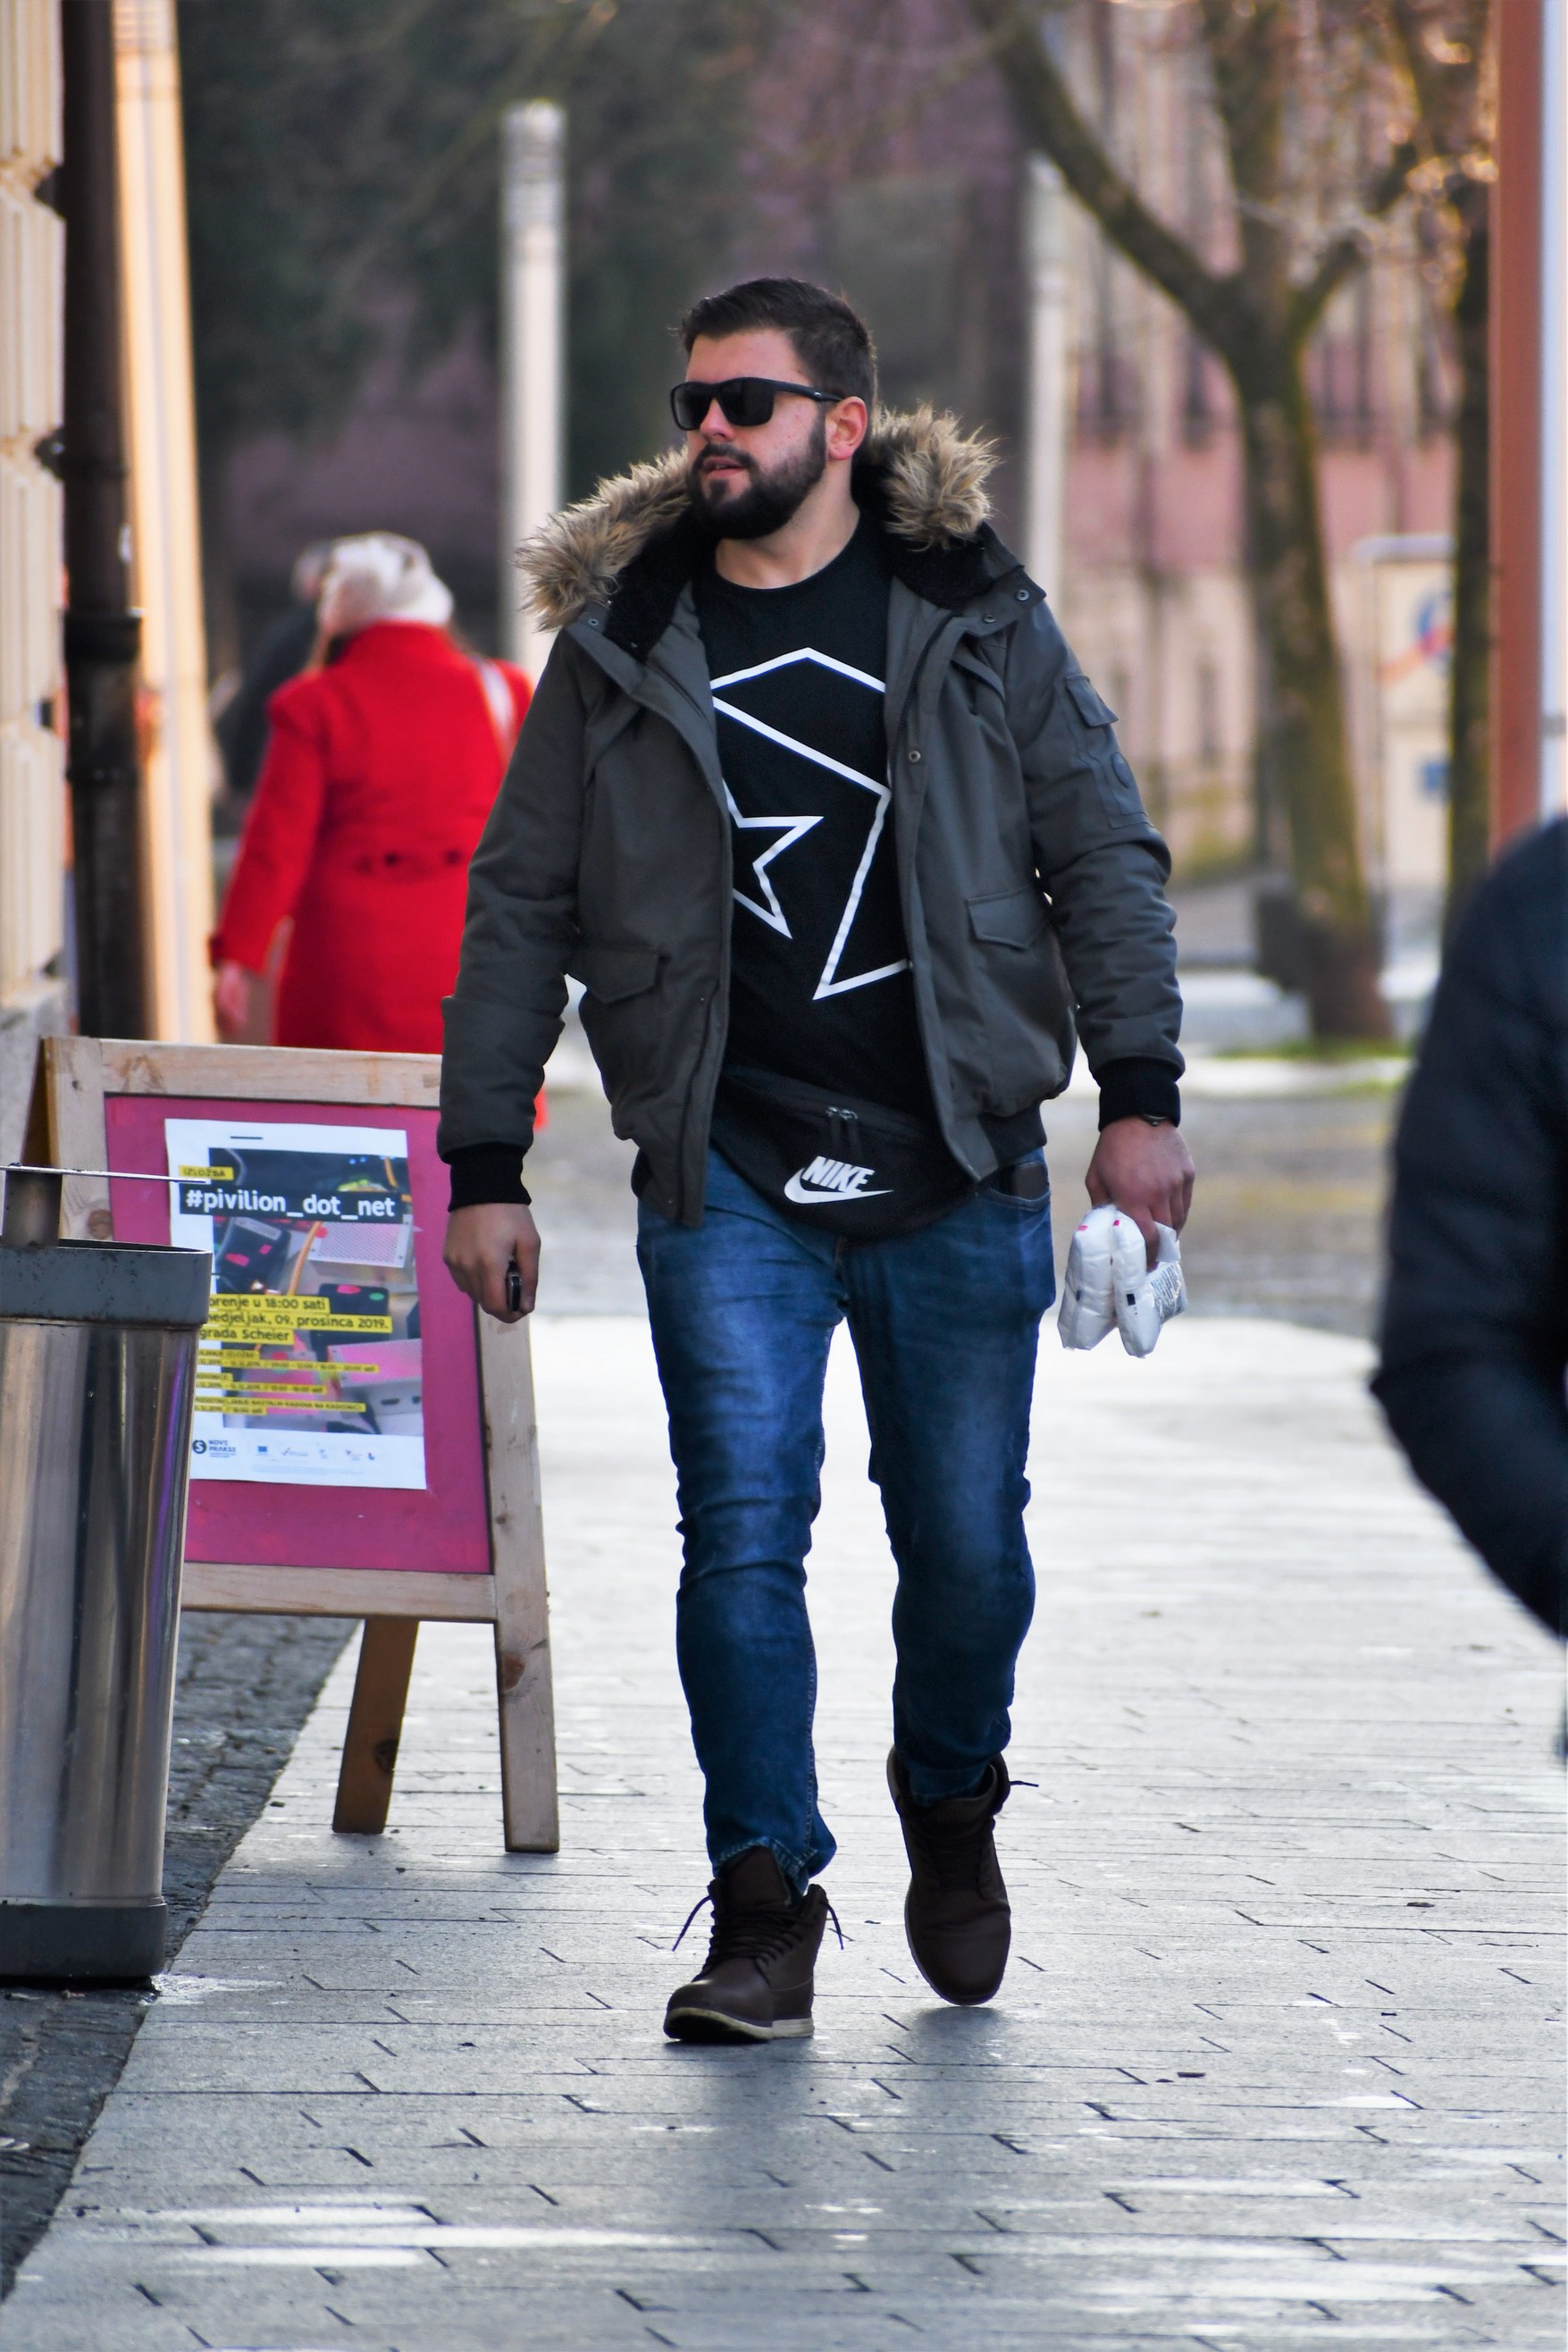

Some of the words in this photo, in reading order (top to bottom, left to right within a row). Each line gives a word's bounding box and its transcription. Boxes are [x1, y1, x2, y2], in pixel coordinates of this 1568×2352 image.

[801, 1155, 876, 1193] NIKE
[186, 1189, 396, 1220] #pivilion_dot_net
[253, 1298, 261, 1307] u
[264, 1298, 298, 1308] 18:00
[303, 1298, 325, 1310] sati
[297, 1315, 354, 1328] prosinca
[358, 1318, 389, 1329] 2019.
[242, 1328, 289, 1340] Scheier
